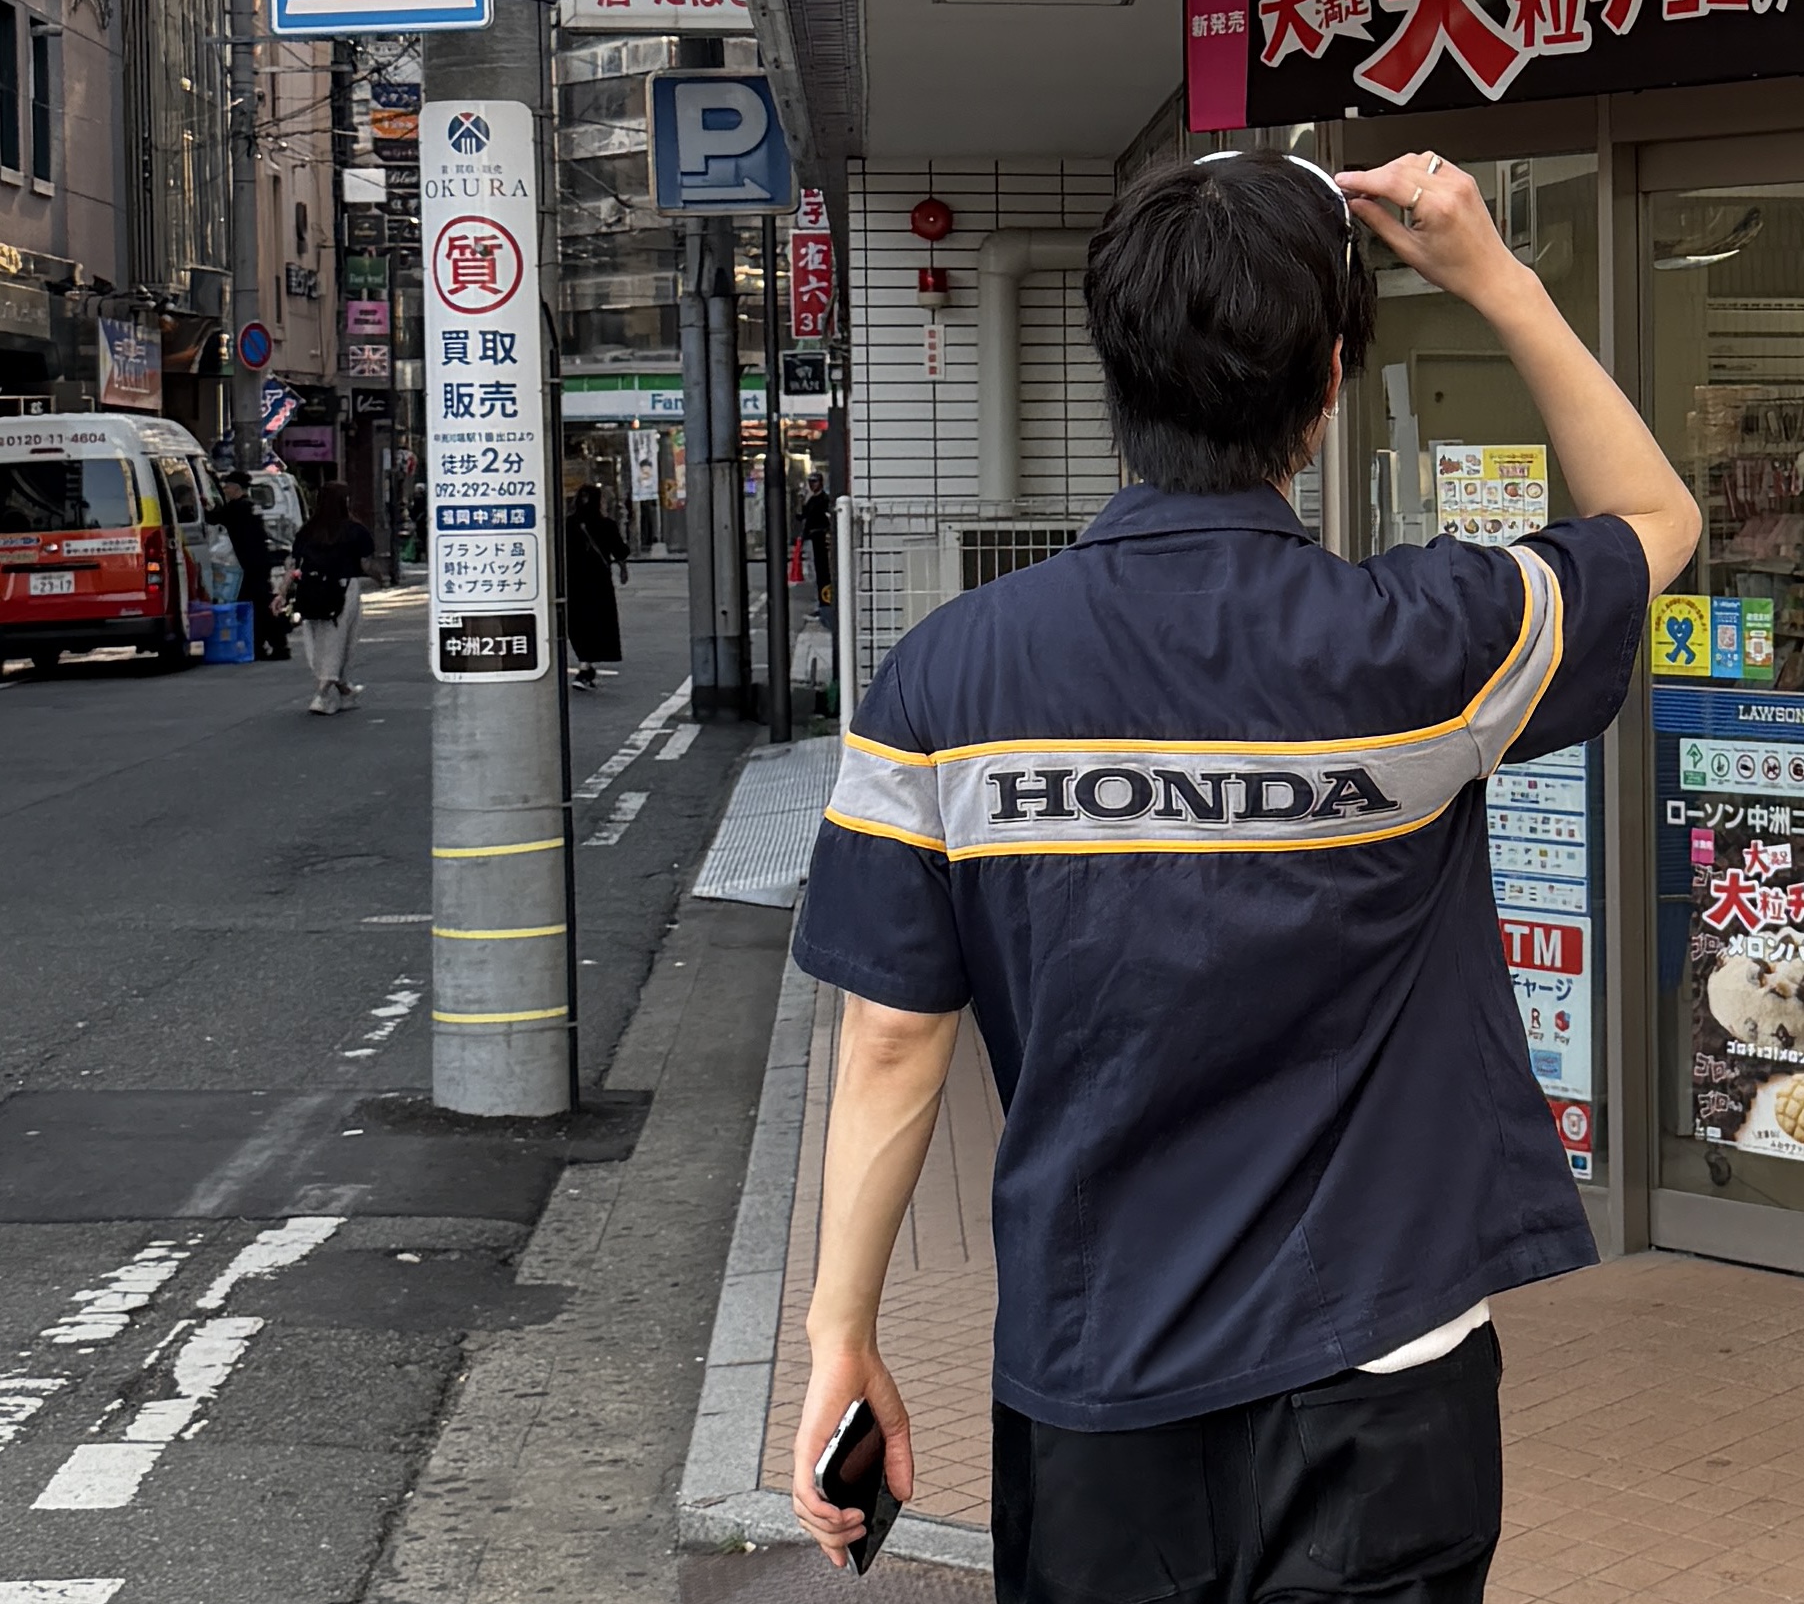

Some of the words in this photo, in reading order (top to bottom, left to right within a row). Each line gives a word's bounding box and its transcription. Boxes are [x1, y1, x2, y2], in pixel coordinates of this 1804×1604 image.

[1191, 10, 1246, 38] 新発売
[675, 82, 768, 172] P
[425, 178, 528, 198] OKURA
[445, 234, 503, 295] 質
[441, 330, 518, 365] 買取
[443, 380, 519, 419] 販売
[441, 447, 524, 475] 徒歩2分
[443, 542, 525, 557] ブランド品
[445, 636, 528, 656] 中洲2丁目
[986, 765, 1401, 824] HONDA
